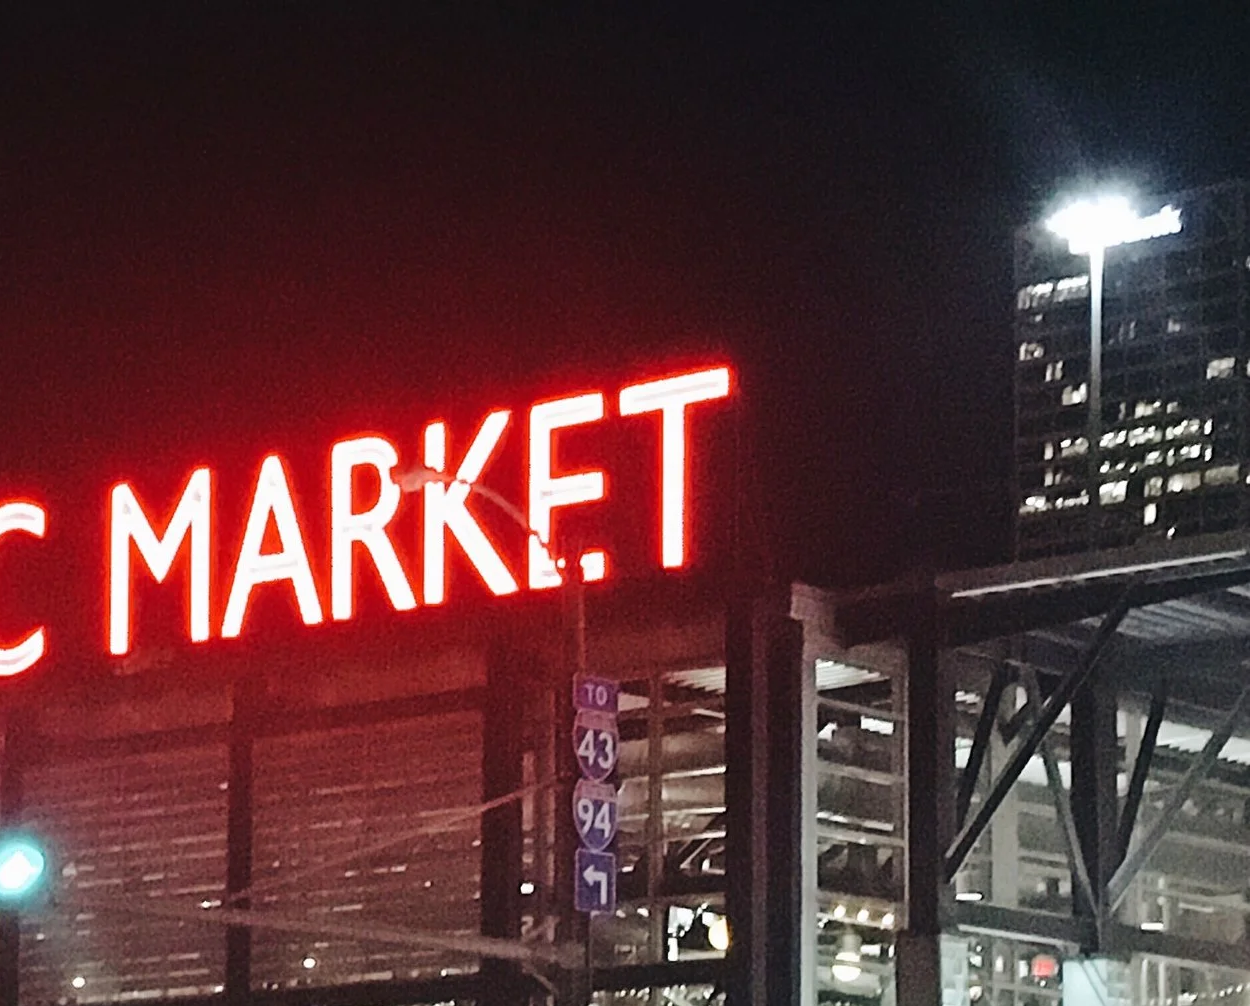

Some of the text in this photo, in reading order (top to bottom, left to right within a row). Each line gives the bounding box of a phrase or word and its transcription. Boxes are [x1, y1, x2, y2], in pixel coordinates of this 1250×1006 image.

[107, 365, 731, 657] MARKET
[584, 684, 608, 706] TO
[578, 729, 614, 769] 43
[577, 798, 611, 839] 94
